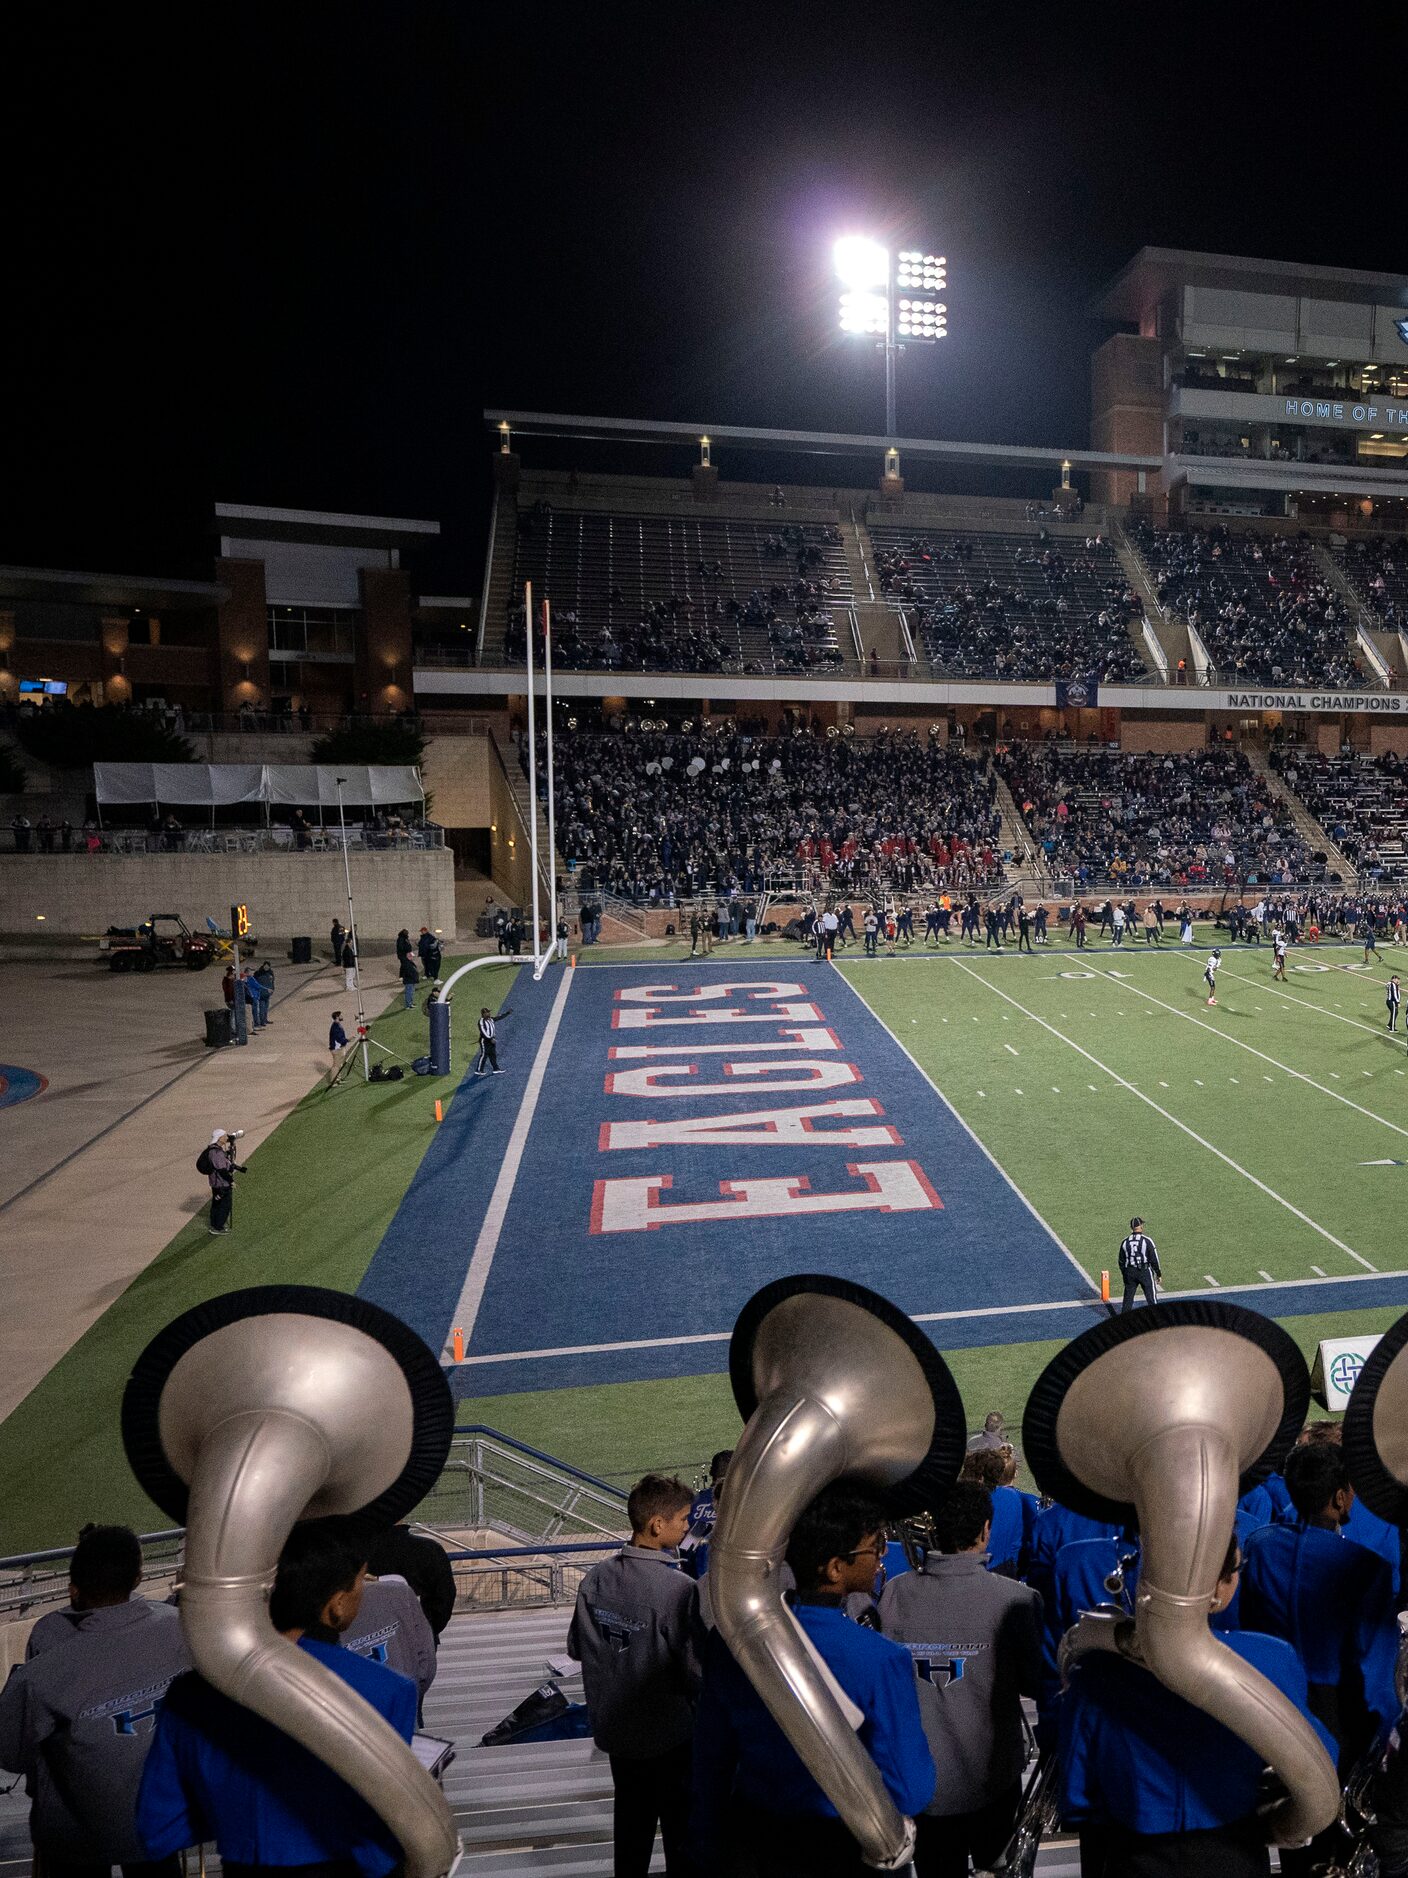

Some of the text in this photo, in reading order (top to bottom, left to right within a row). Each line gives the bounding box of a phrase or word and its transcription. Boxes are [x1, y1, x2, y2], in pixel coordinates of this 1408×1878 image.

[1285, 400, 1343, 419] HOME
[1352, 406, 1378, 421] OF
[1228, 694, 1306, 709] NATIONAL
[1310, 696, 1400, 711] CHAMPIONS
[589, 982, 945, 1235] EAGLES
